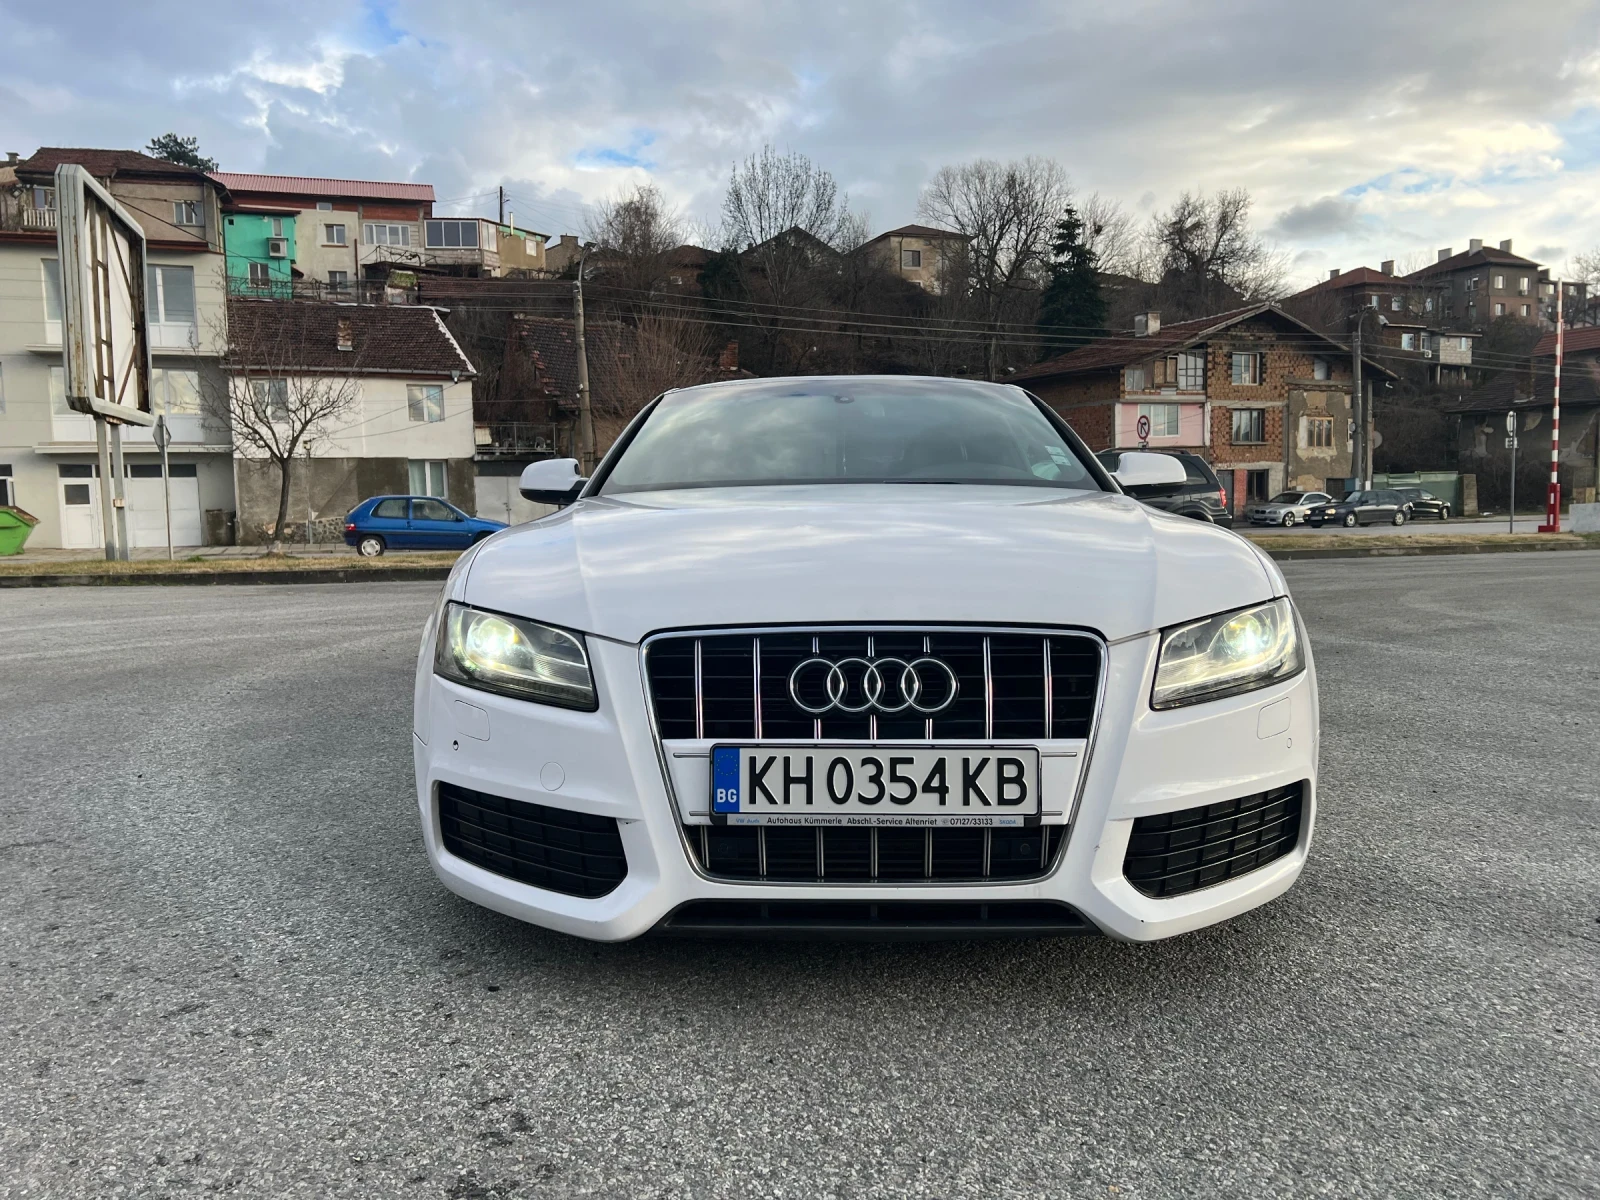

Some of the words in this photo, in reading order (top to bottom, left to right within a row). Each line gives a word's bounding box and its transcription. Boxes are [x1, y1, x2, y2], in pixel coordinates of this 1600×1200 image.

[748, 755, 814, 805] KH
[826, 756, 950, 806] 0354
[962, 757, 1028, 806] KB
[716, 788, 738, 803] BG
[766, 817, 802, 825] Autohaus
[804, 817, 842, 825] Kümmerle
[905, 818, 937, 826] Altenriet
[950, 818, 993, 827] 07127/33133
